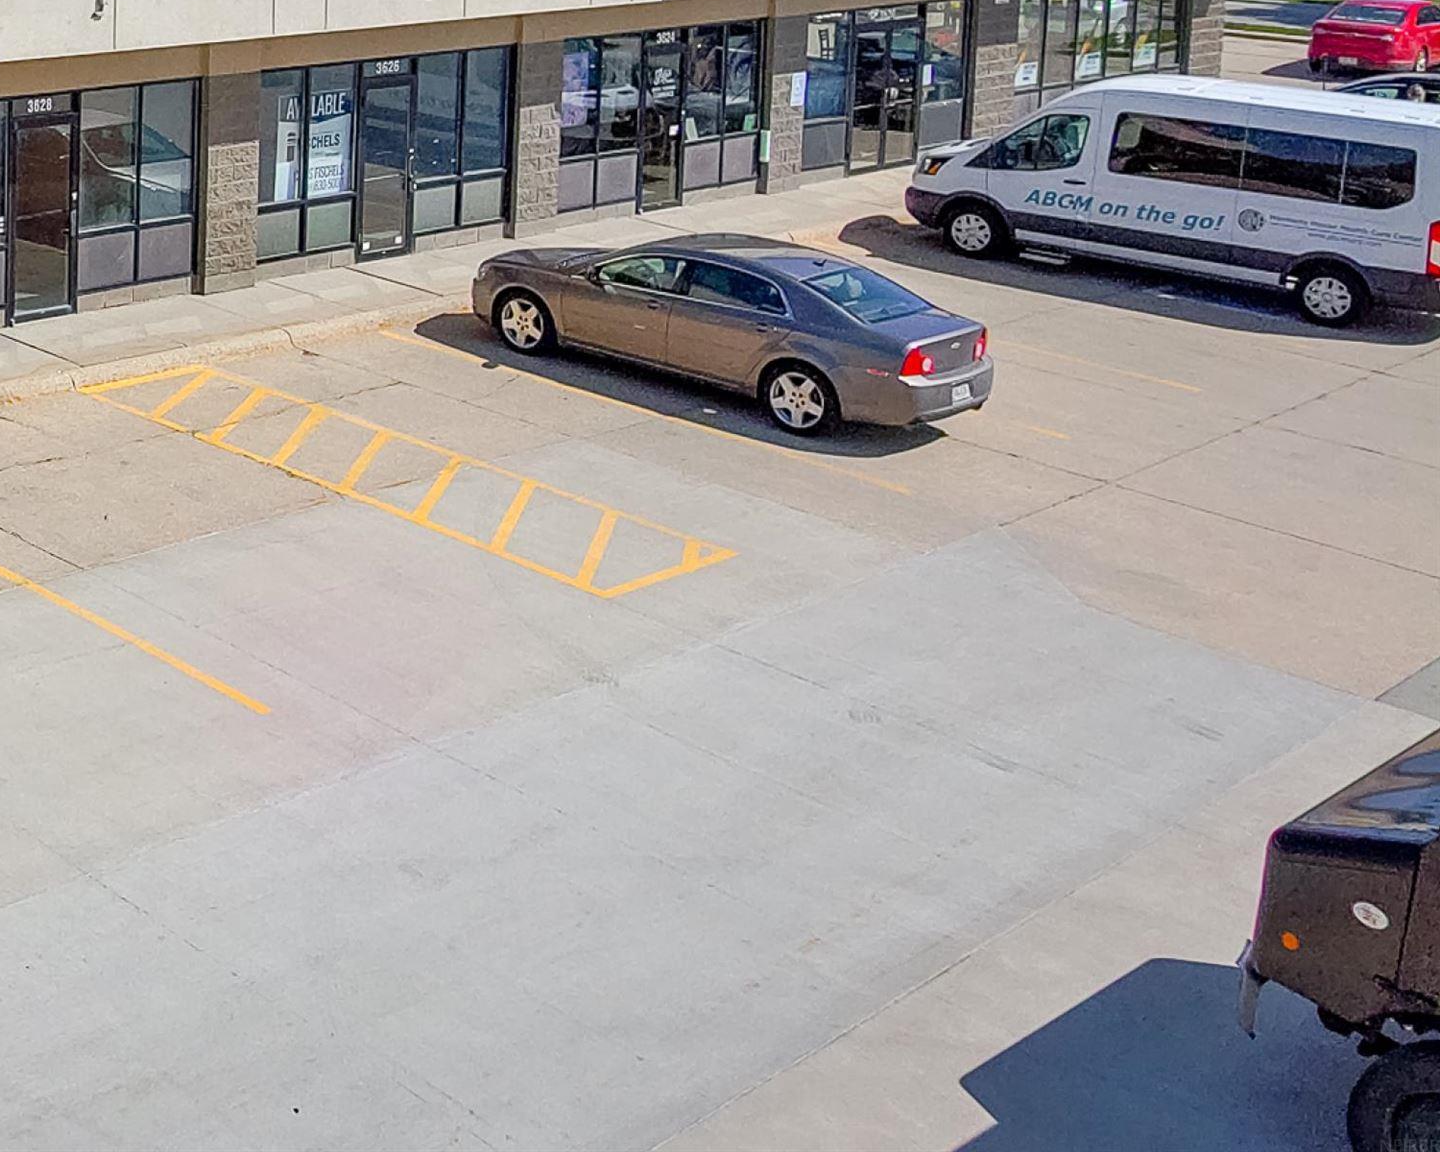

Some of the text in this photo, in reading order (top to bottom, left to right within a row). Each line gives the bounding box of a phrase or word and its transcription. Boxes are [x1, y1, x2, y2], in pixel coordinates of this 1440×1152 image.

[375, 60, 400, 74] 3626
[27, 97, 53, 113] 3628
[1024, 189, 1226, 231] ABCM on the go!
